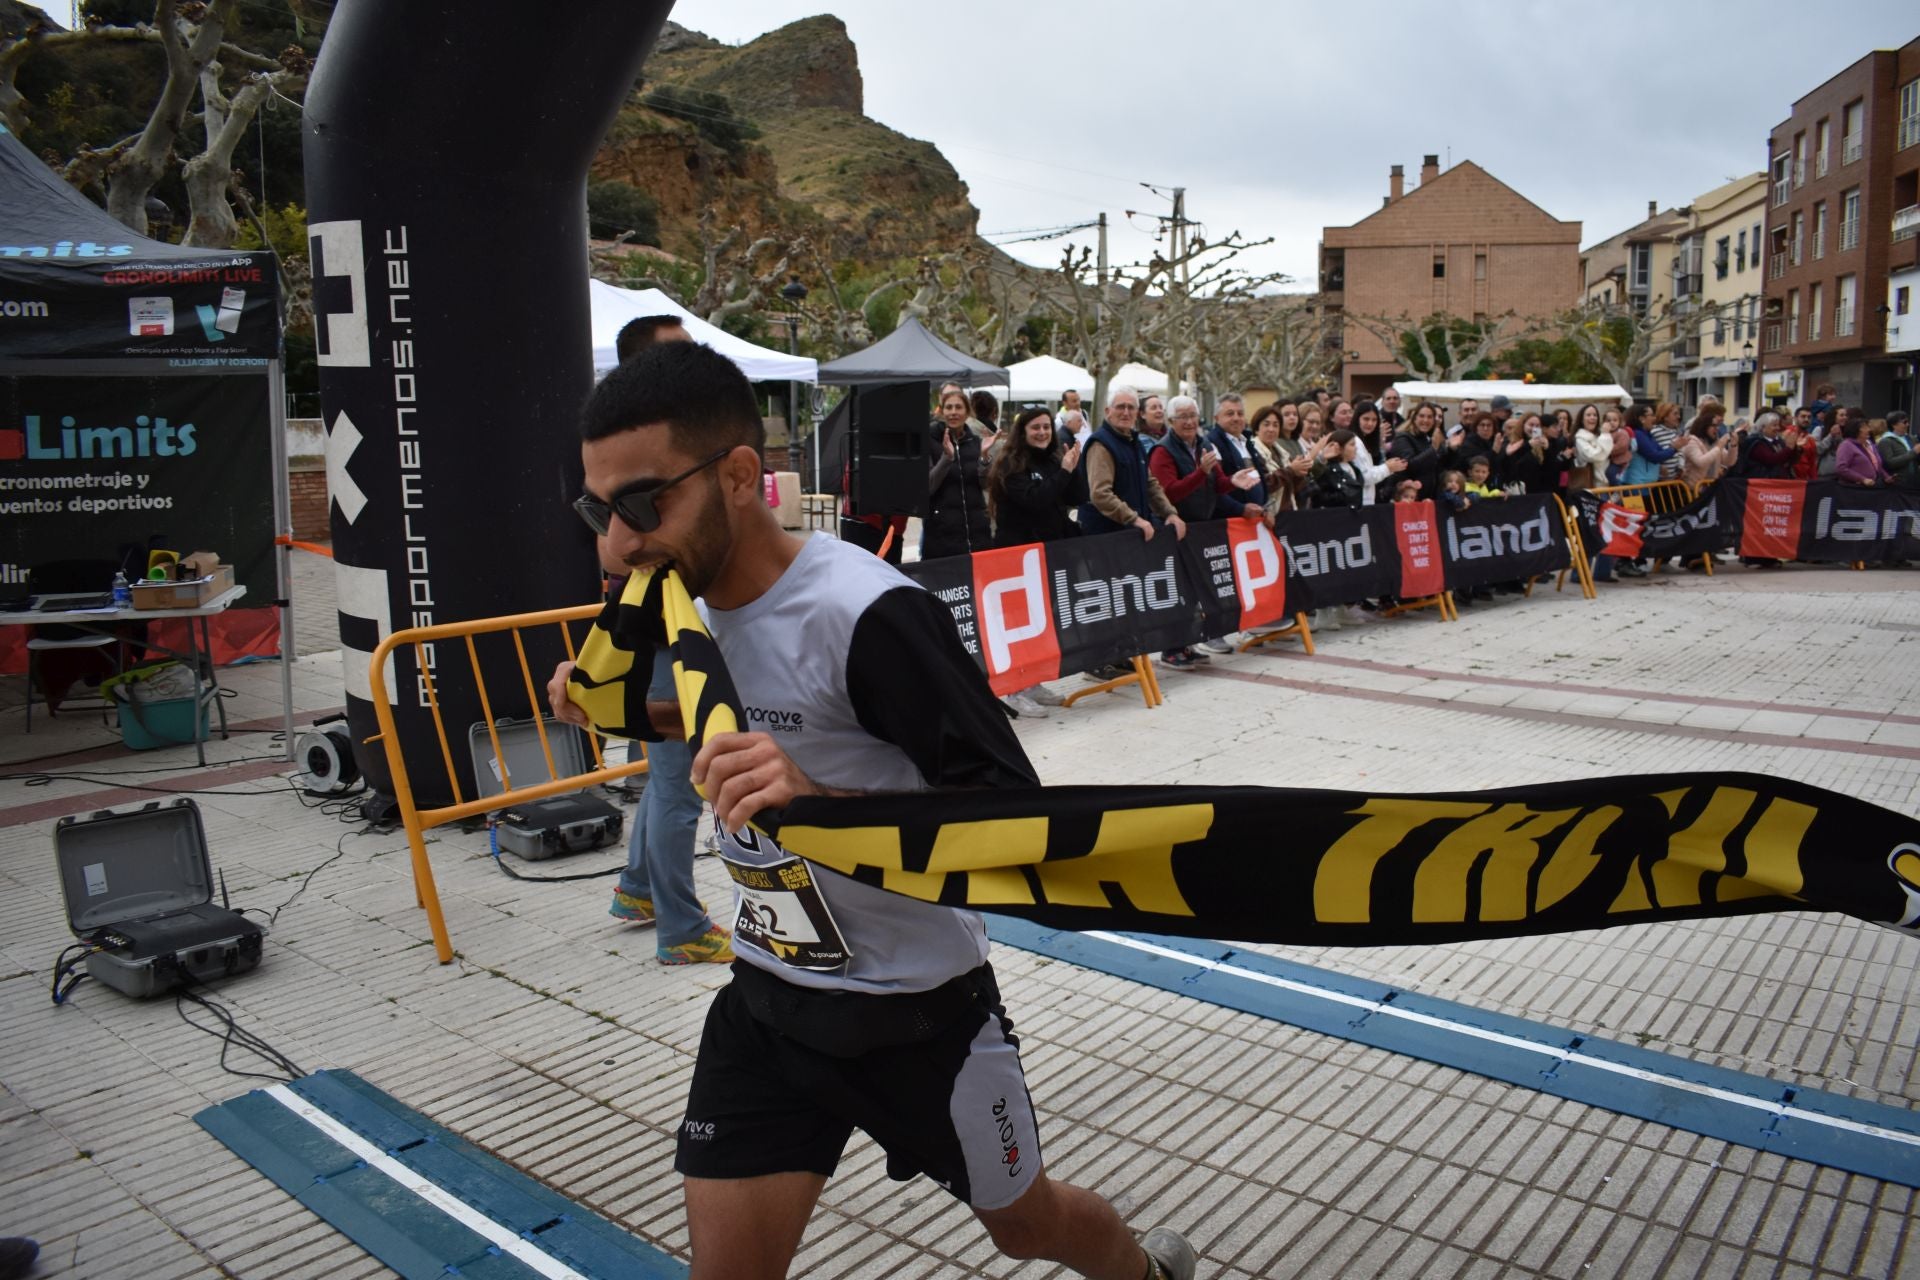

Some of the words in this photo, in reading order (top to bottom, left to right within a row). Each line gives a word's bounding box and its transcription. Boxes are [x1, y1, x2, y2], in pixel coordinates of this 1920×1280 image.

[225, 268, 262, 283] LIVE
[26, 415, 197, 459] Limits
[0, 471, 132, 490] cronometraje
[137, 474, 150, 488] y
[68, 494, 173, 514] deportivos
[1758, 492, 1792, 503] CHANGES
[1763, 503, 1791, 514] STARTS
[1763, 515, 1774, 526] ON
[1775, 516, 1788, 526] THE
[1763, 527, 1789, 537] INSIDE
[1203, 544, 1228, 559] CHANGES
[1210, 558, 1231, 571] STARTS
[1213, 573, 1222, 585] ON
[1222, 571, 1232, 583] THE
[931, 585, 970, 603] ANGES
[1217, 584, 1236, 598] INSIDE
[771, 724, 803, 732] SPORT
